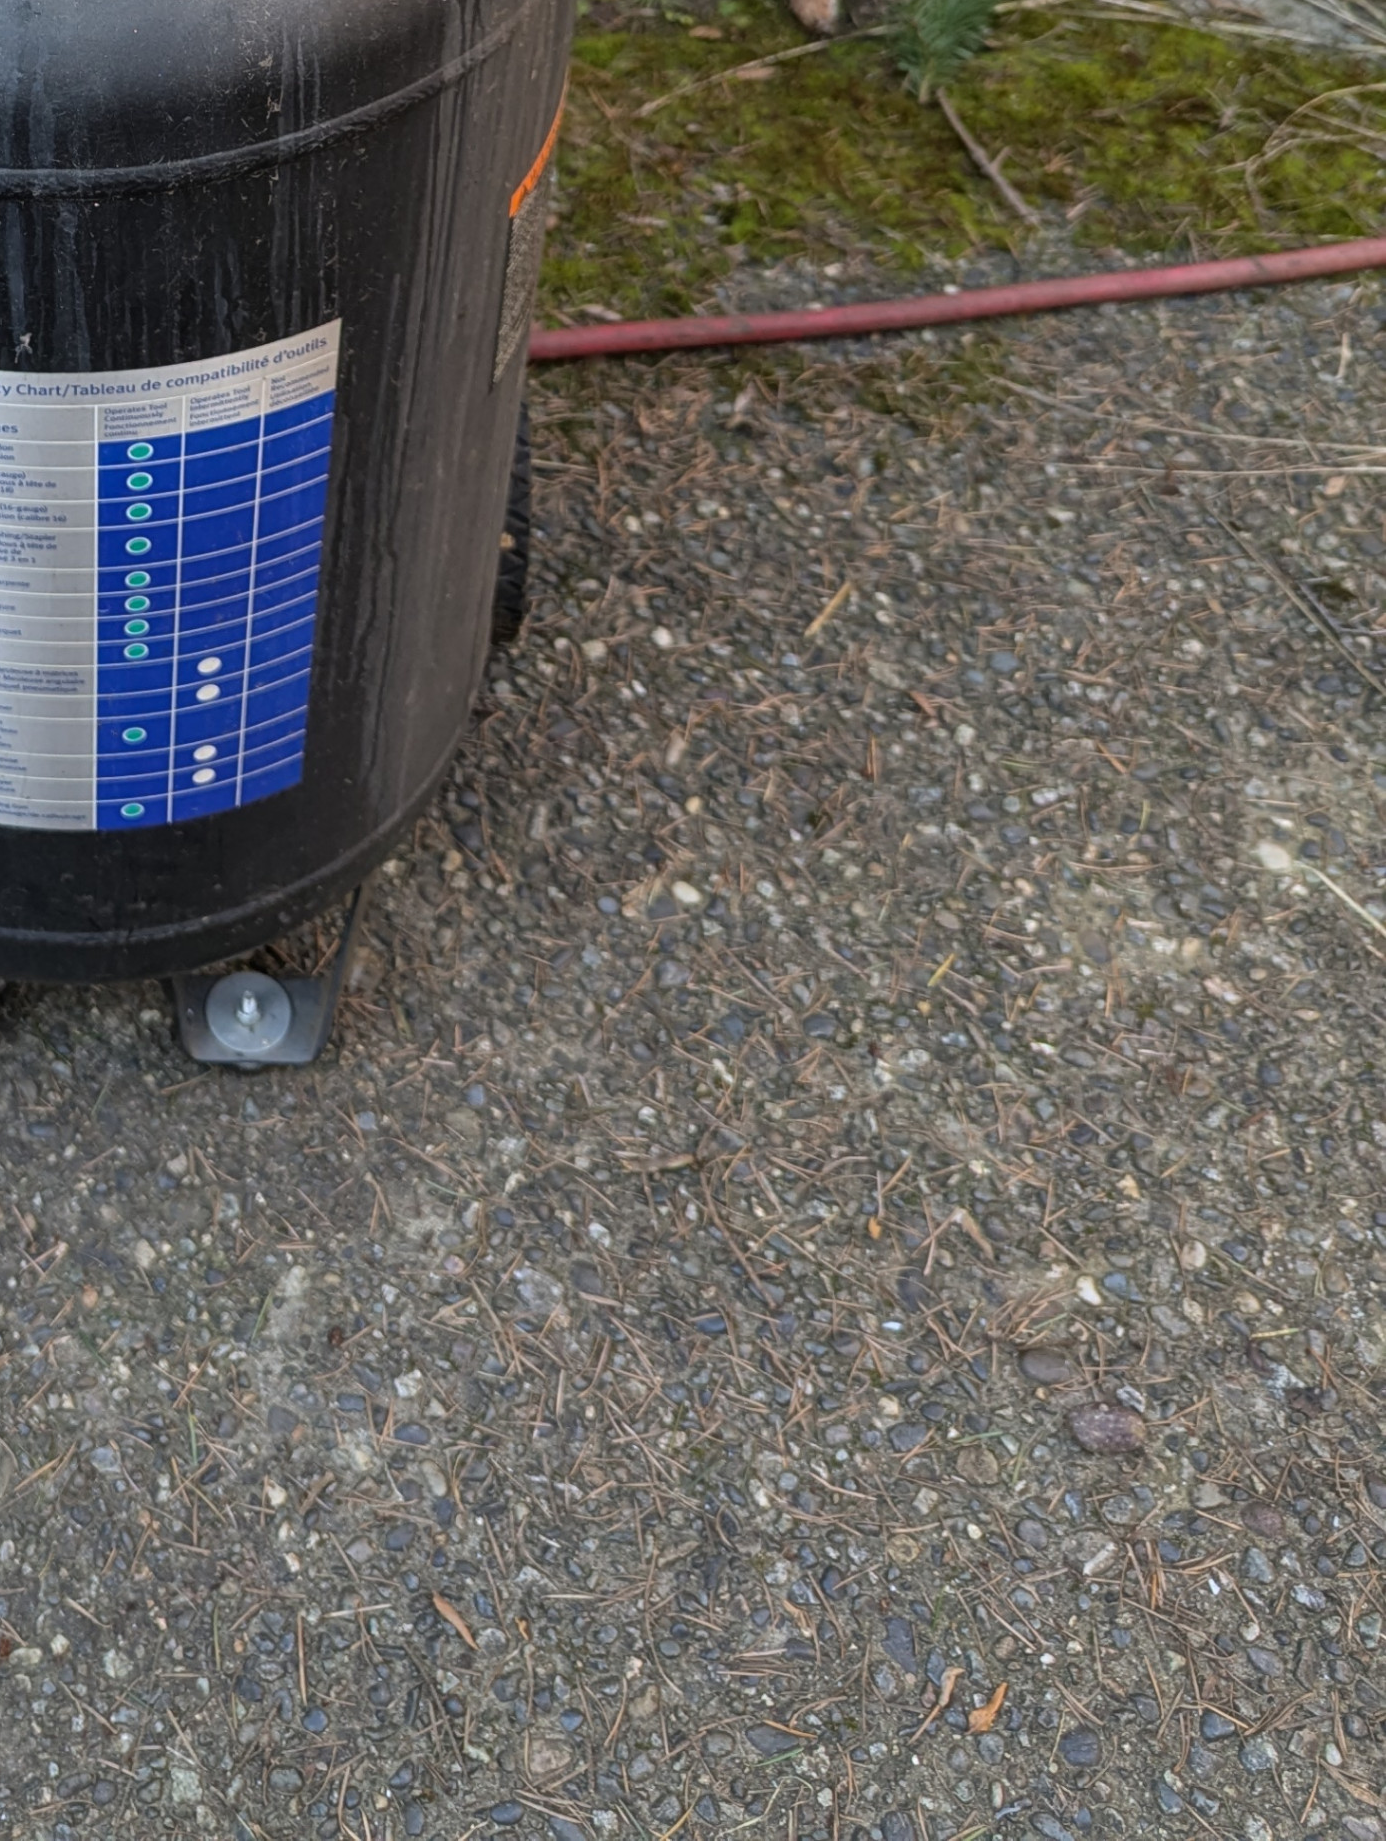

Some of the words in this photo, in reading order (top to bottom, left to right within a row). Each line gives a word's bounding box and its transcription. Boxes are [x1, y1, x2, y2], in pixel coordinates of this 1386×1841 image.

[15, 380, 136, 398] Chart/Tableau
[141, 379, 162, 393] de
[165, 355, 270, 390] compatibilité
[272, 337, 328, 365] d'outils
